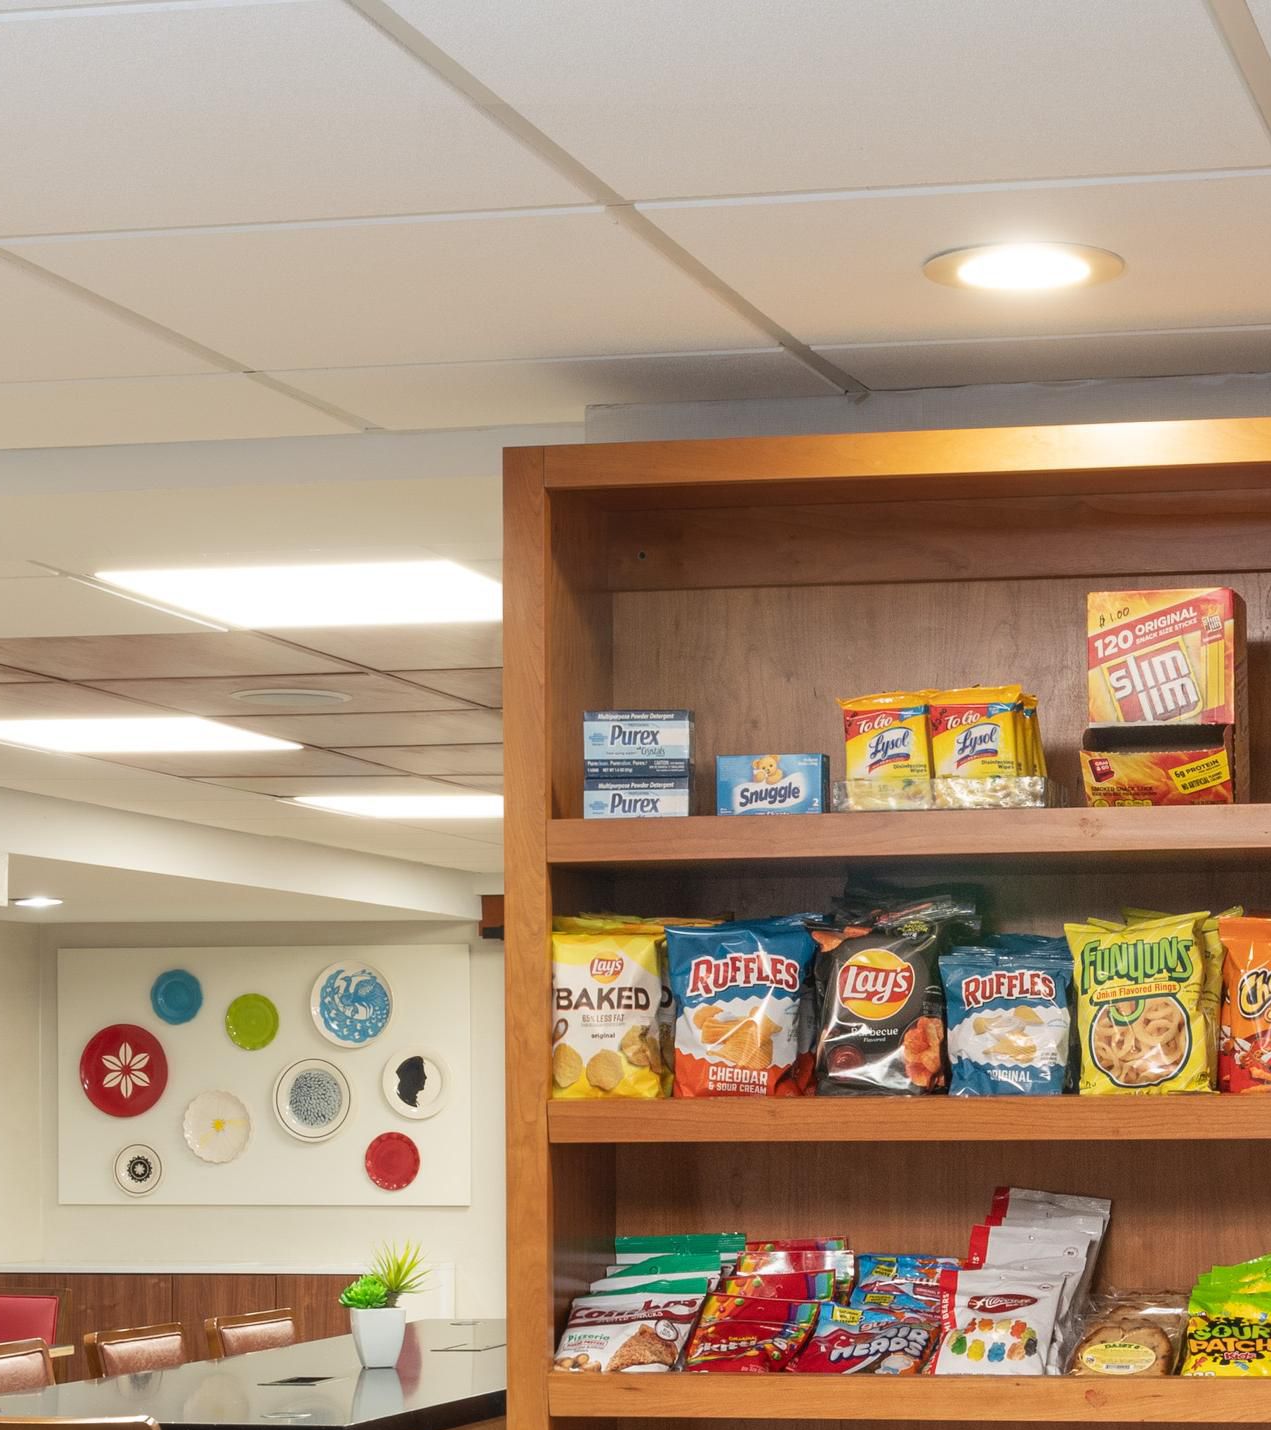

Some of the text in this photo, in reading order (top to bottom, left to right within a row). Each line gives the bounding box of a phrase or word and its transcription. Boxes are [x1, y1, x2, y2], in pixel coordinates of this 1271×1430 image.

[1094, 606, 1197, 659] 120 ORIGINAL
[1136, 618, 1197, 644] SNACK SIZE STICKS
[857, 715, 893, 734] To Go
[945, 711, 980, 730] To Go
[610, 725, 659, 745] Purex
[869, 729, 909, 759] Lysol
[956, 725, 997, 755] Lysol
[1175, 759, 1219, 778] 6g PROTEIN
[610, 793, 659, 813] Purex
[739, 782, 800, 807] Snuggle
[591, 956, 623, 977] Lay's
[686, 952, 800, 997] RUFFLES
[1081, 936, 1194, 996] FUNYUNS
[842, 966, 909, 1004] Lay's
[962, 969, 1056, 1009] RUFFLES
[1118, 984, 1152, 998] Flavored
[1154, 982, 1178, 994] Rings
[555, 987, 651, 1011] BAKED
[581, 1014, 625, 1022] 65% LESS FAT
[591, 1032, 616, 1040] original
[708, 1066, 768, 1086] CHEDDAR
[716, 1083, 737, 1092] SOUR
[739, 1085, 767, 1095] CREAM
[880, 1327, 929, 1342] AIR
[1193, 1322, 1270, 1339] SOUR
[830, 1339, 923, 1363] HEADS
